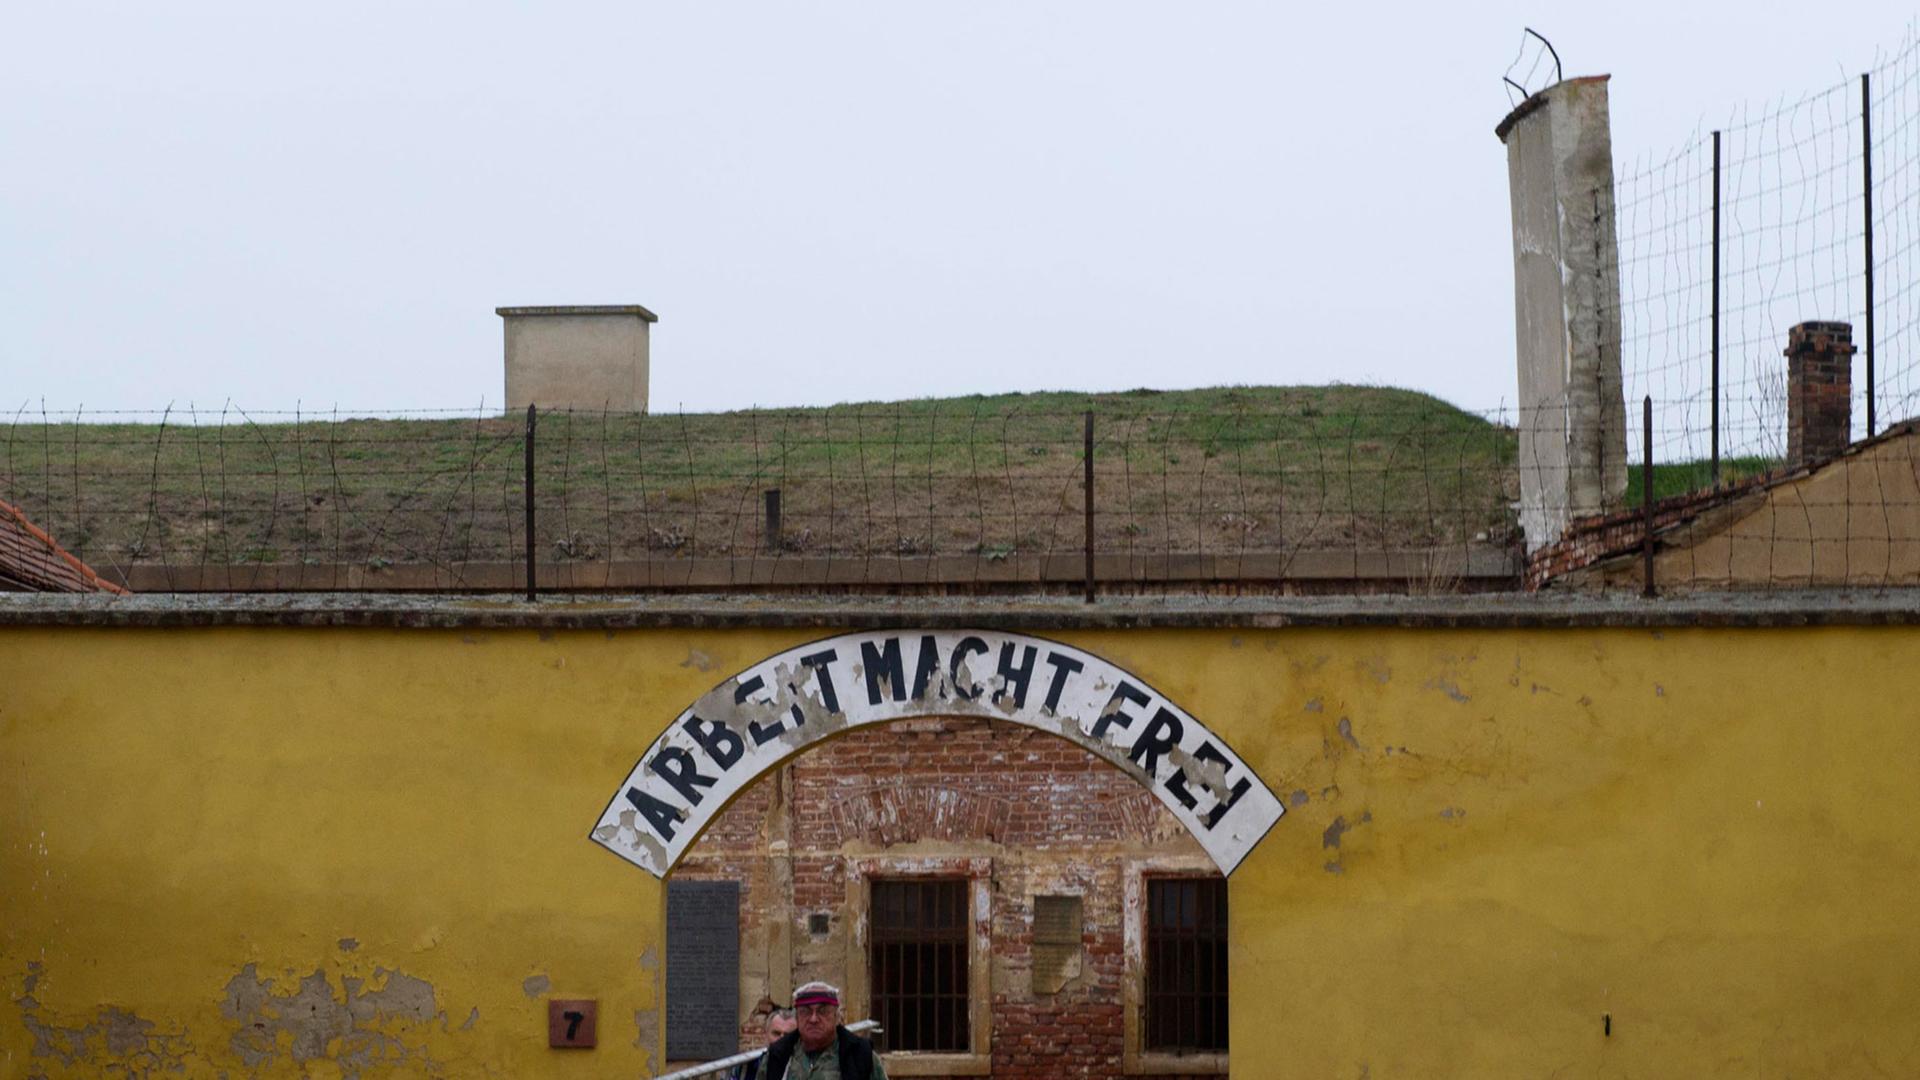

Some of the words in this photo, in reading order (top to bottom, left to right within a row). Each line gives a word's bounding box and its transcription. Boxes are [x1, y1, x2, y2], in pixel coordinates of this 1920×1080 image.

[861, 635, 1084, 717] MACHT
[1090, 680, 1252, 831] FREI
[563, 1011, 584, 1040] 7
